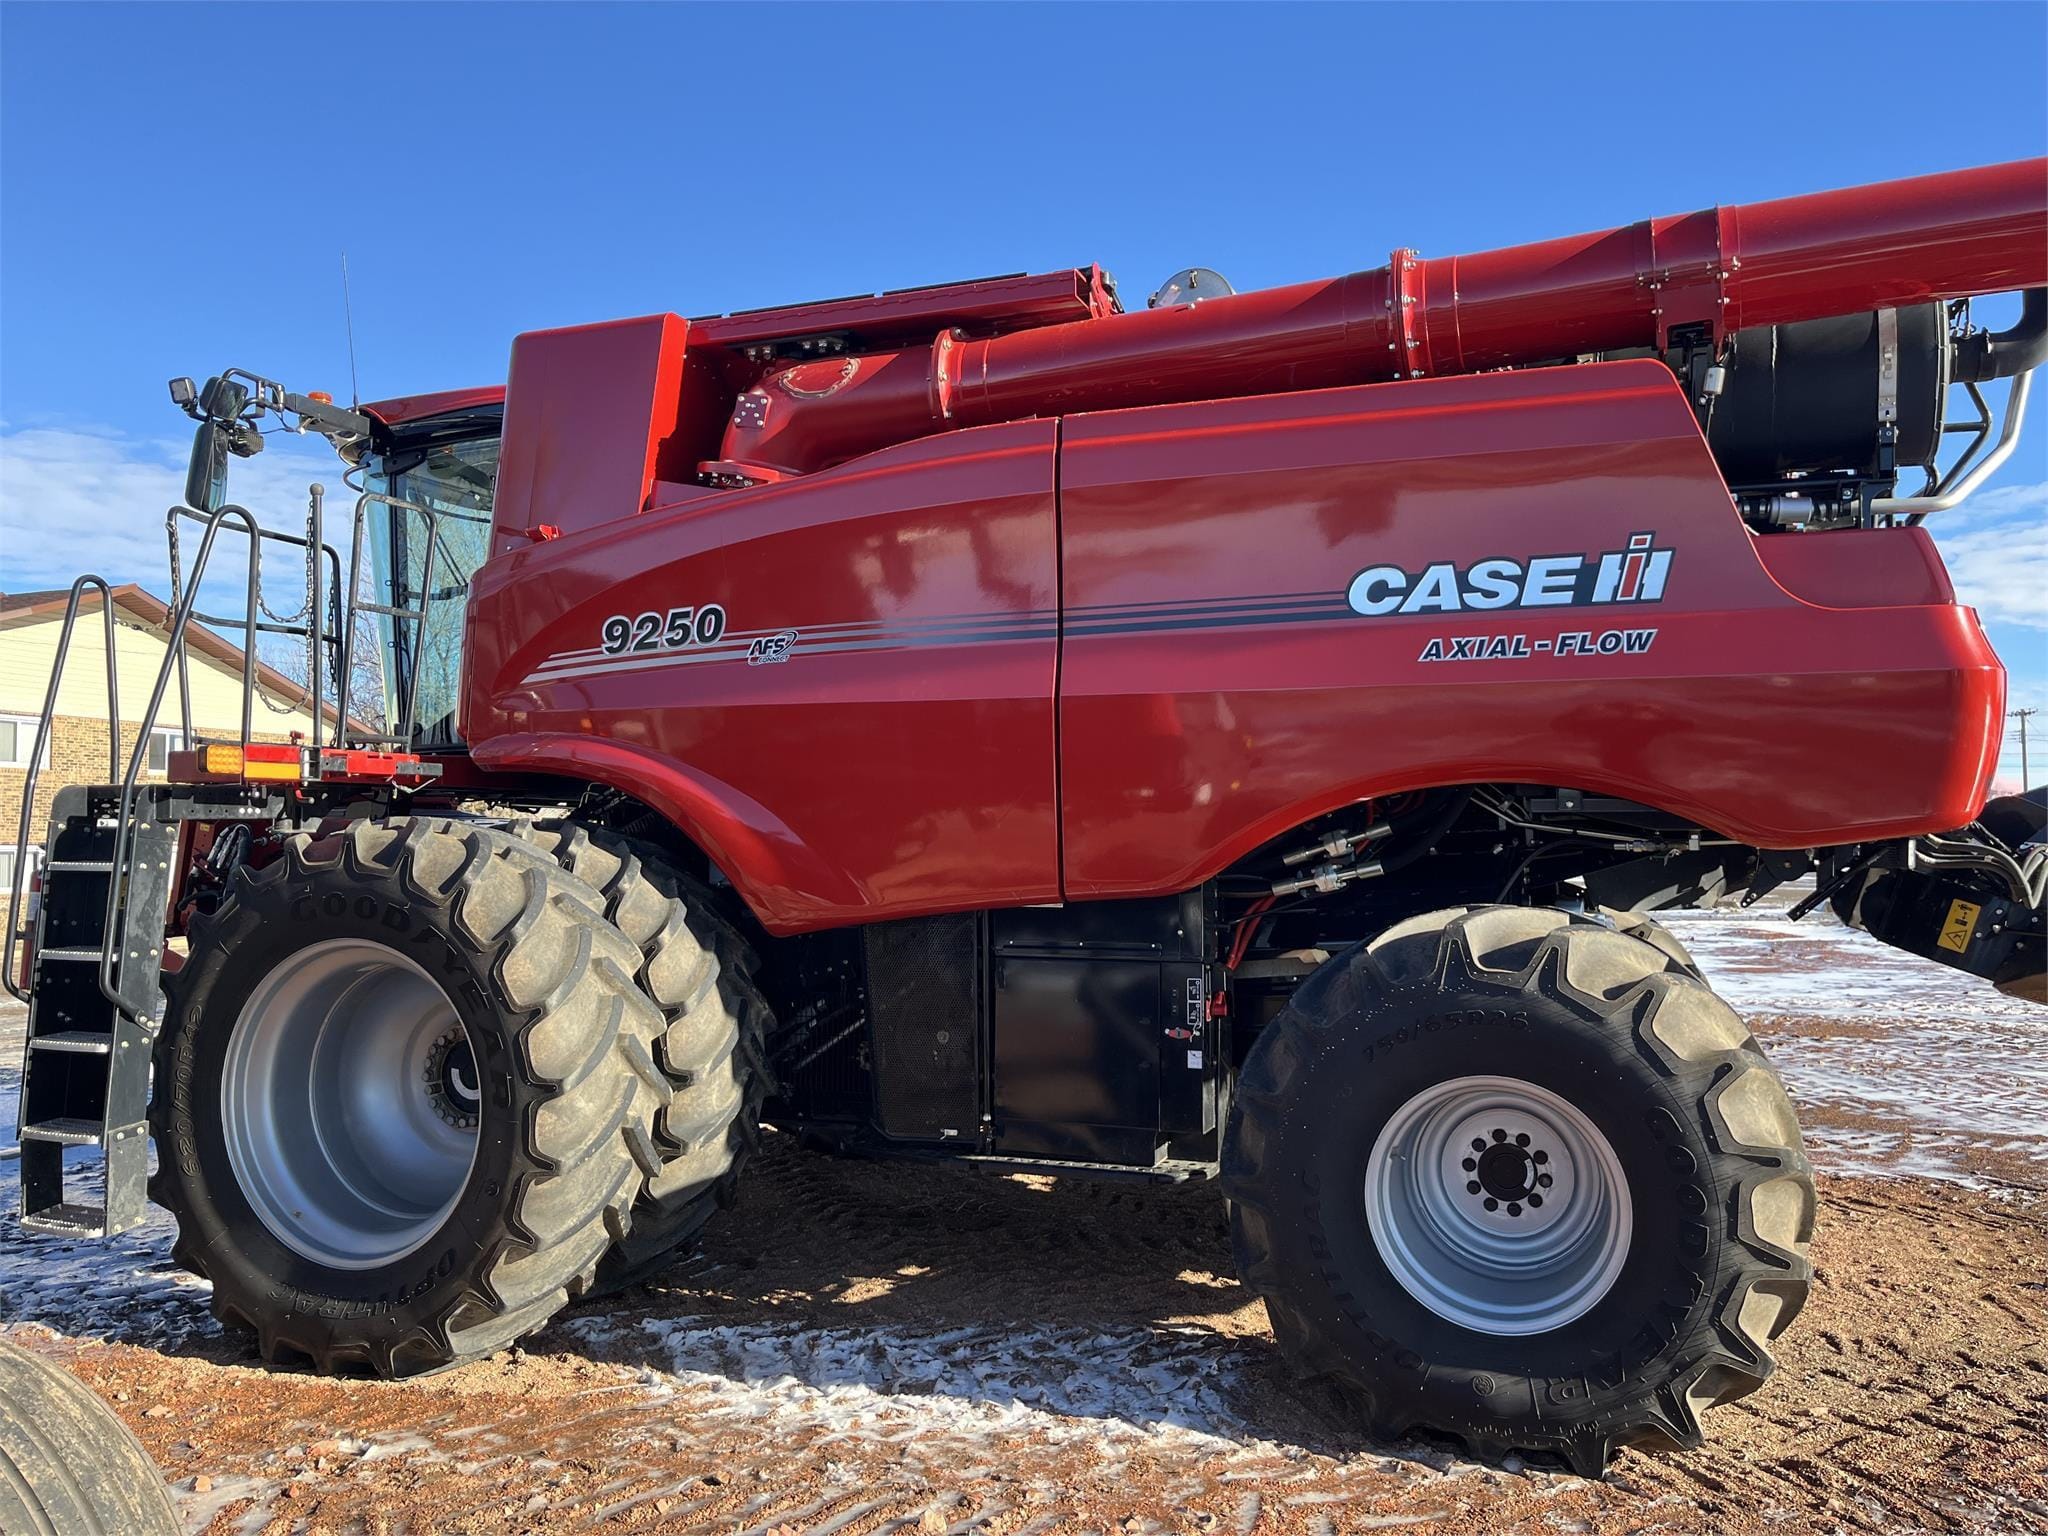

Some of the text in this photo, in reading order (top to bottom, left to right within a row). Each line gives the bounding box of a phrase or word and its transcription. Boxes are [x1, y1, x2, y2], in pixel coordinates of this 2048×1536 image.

[601, 603, 726, 655] 9250
[1347, 556, 1583, 616] CASE
[747, 636, 788, 655] AFS
[291, 891, 511, 1108] GOODYEAR
[172, 1005, 203, 1177] 620/70R42
[1545, 1106, 1709, 1406] GOODYEAR
